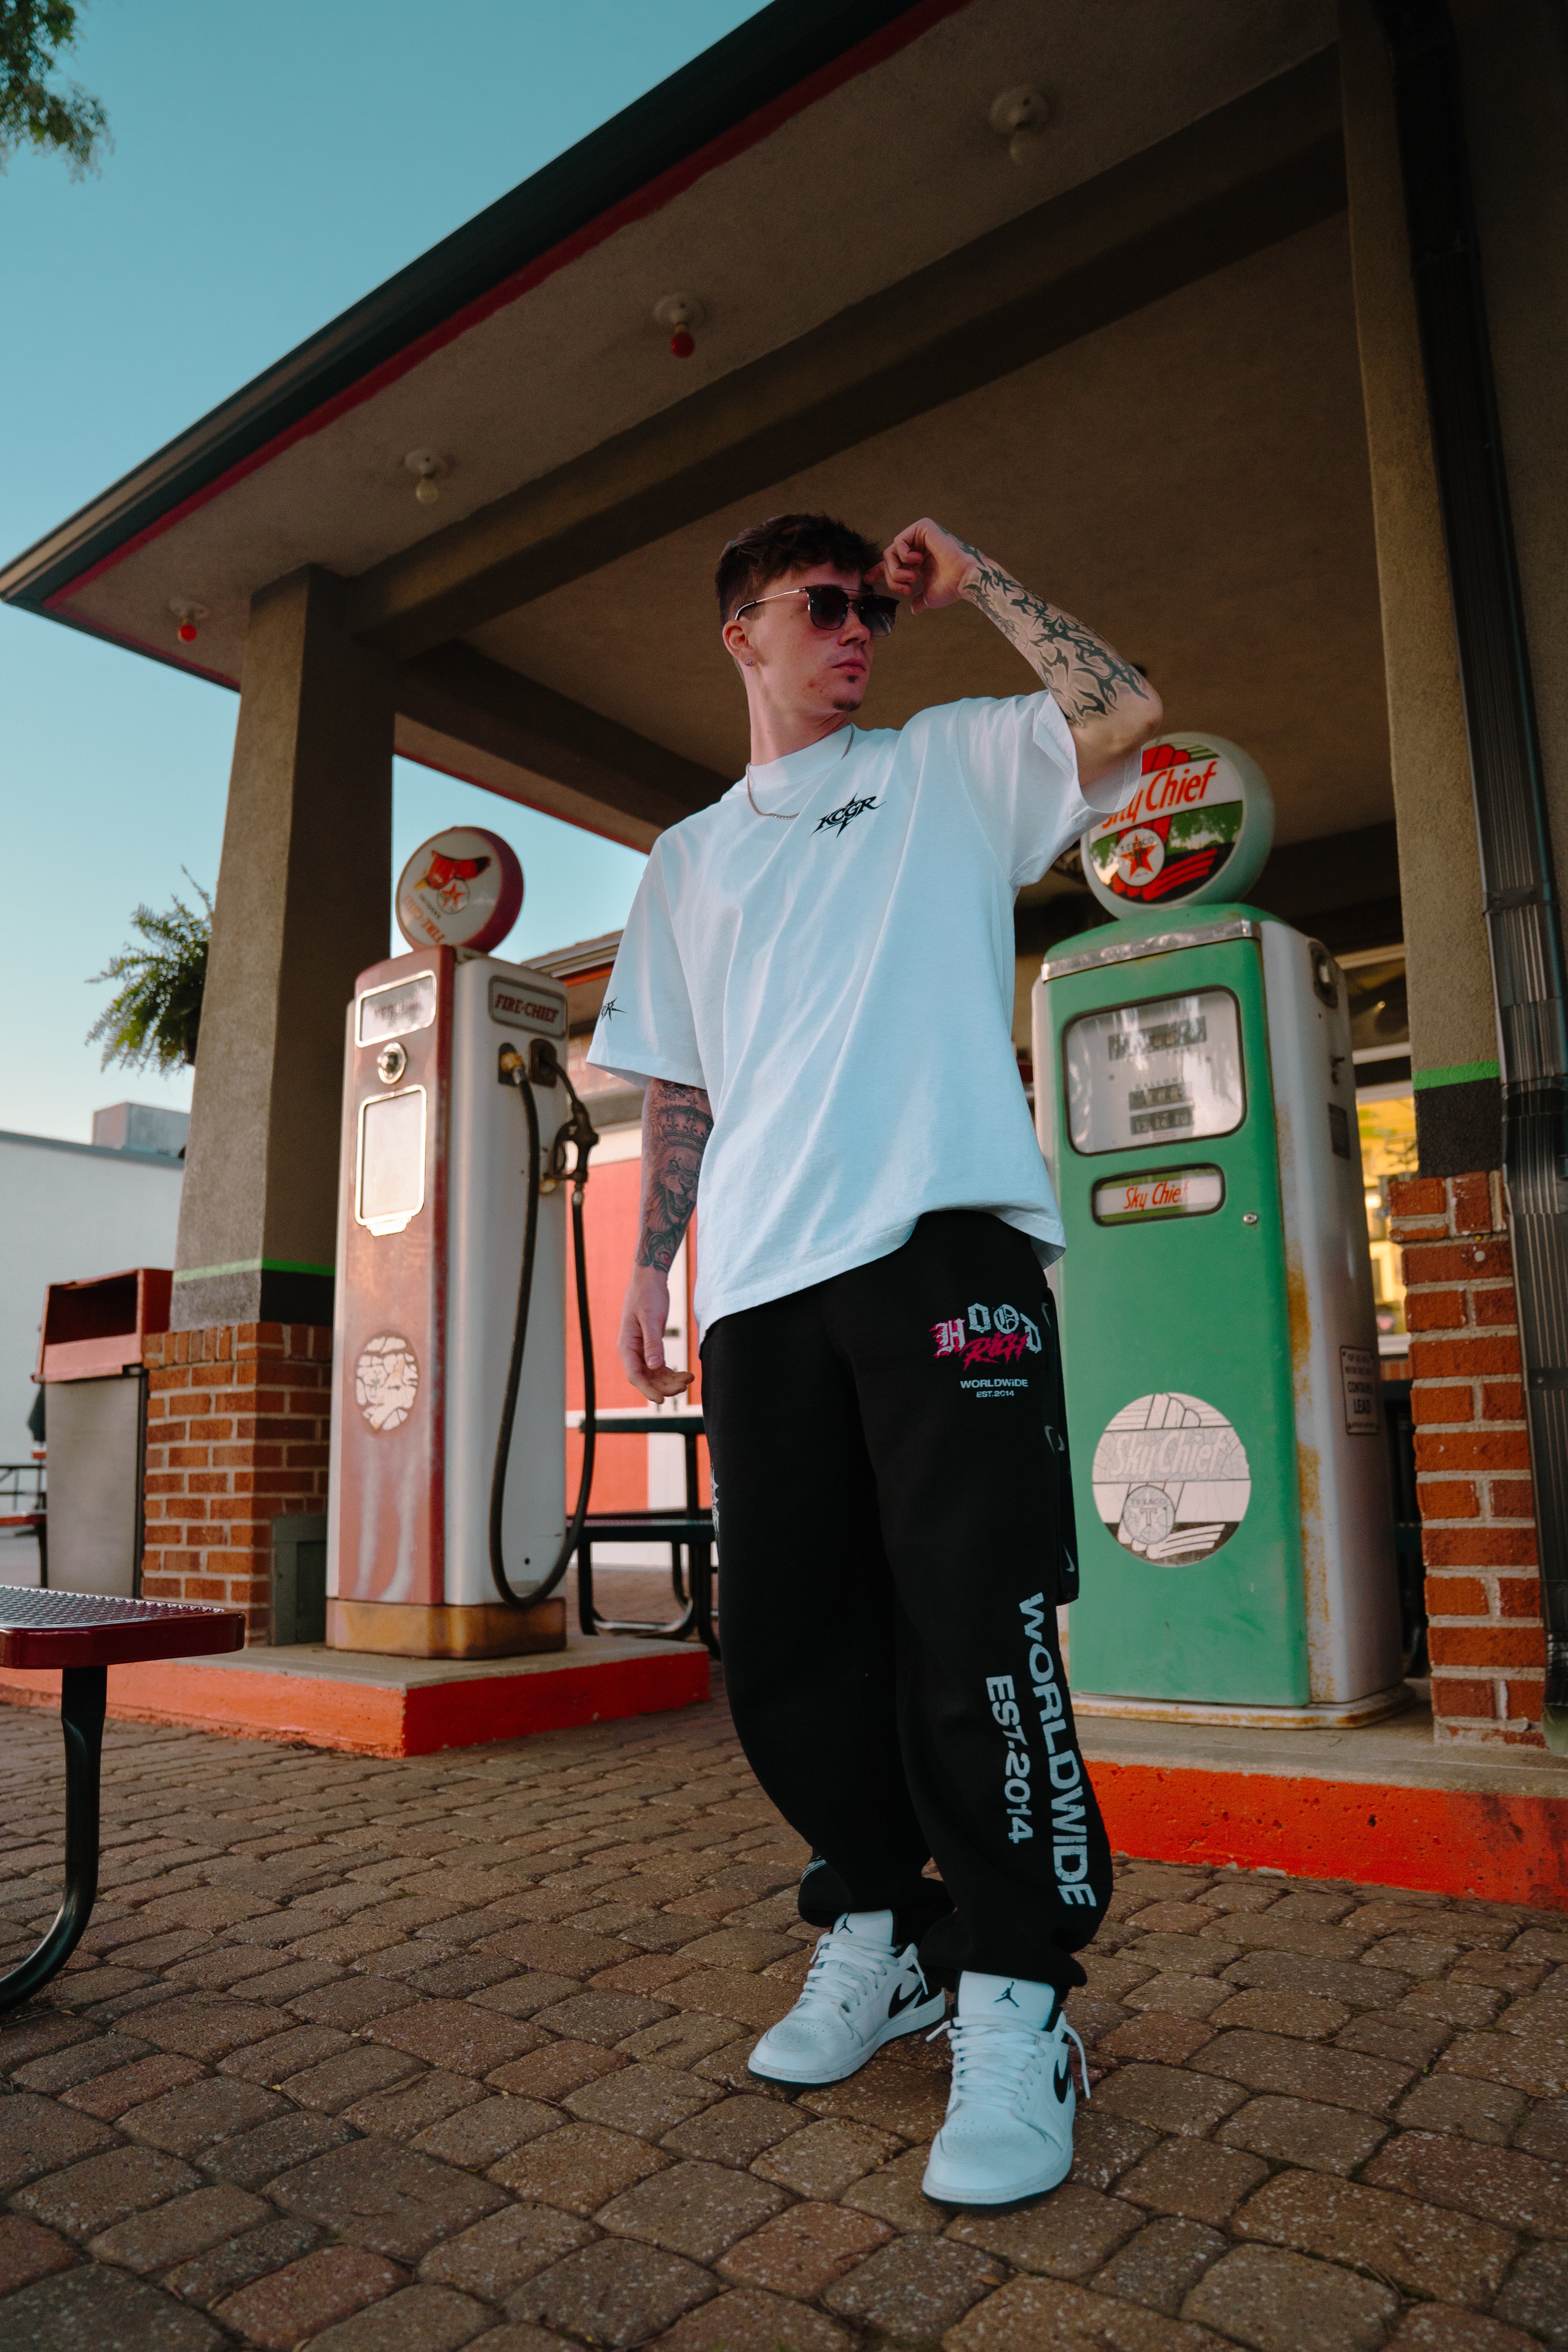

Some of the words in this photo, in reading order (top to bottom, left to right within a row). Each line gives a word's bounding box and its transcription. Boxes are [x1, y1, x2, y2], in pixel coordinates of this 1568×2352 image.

[1145, 760, 1217, 812] Chief
[809, 793, 887, 838] KCGR
[1124, 1186, 1148, 1210] Sky
[929, 1303, 1042, 1359] HOOD
[960, 1379, 1029, 1388] WORLDWIDE
[1110, 1432, 1156, 1481] Sky
[1159, 1430, 1227, 1473] Chief
[986, 1675, 1033, 1844] EST.2014
[1019, 1592, 1097, 1907] WORLDWIDE
